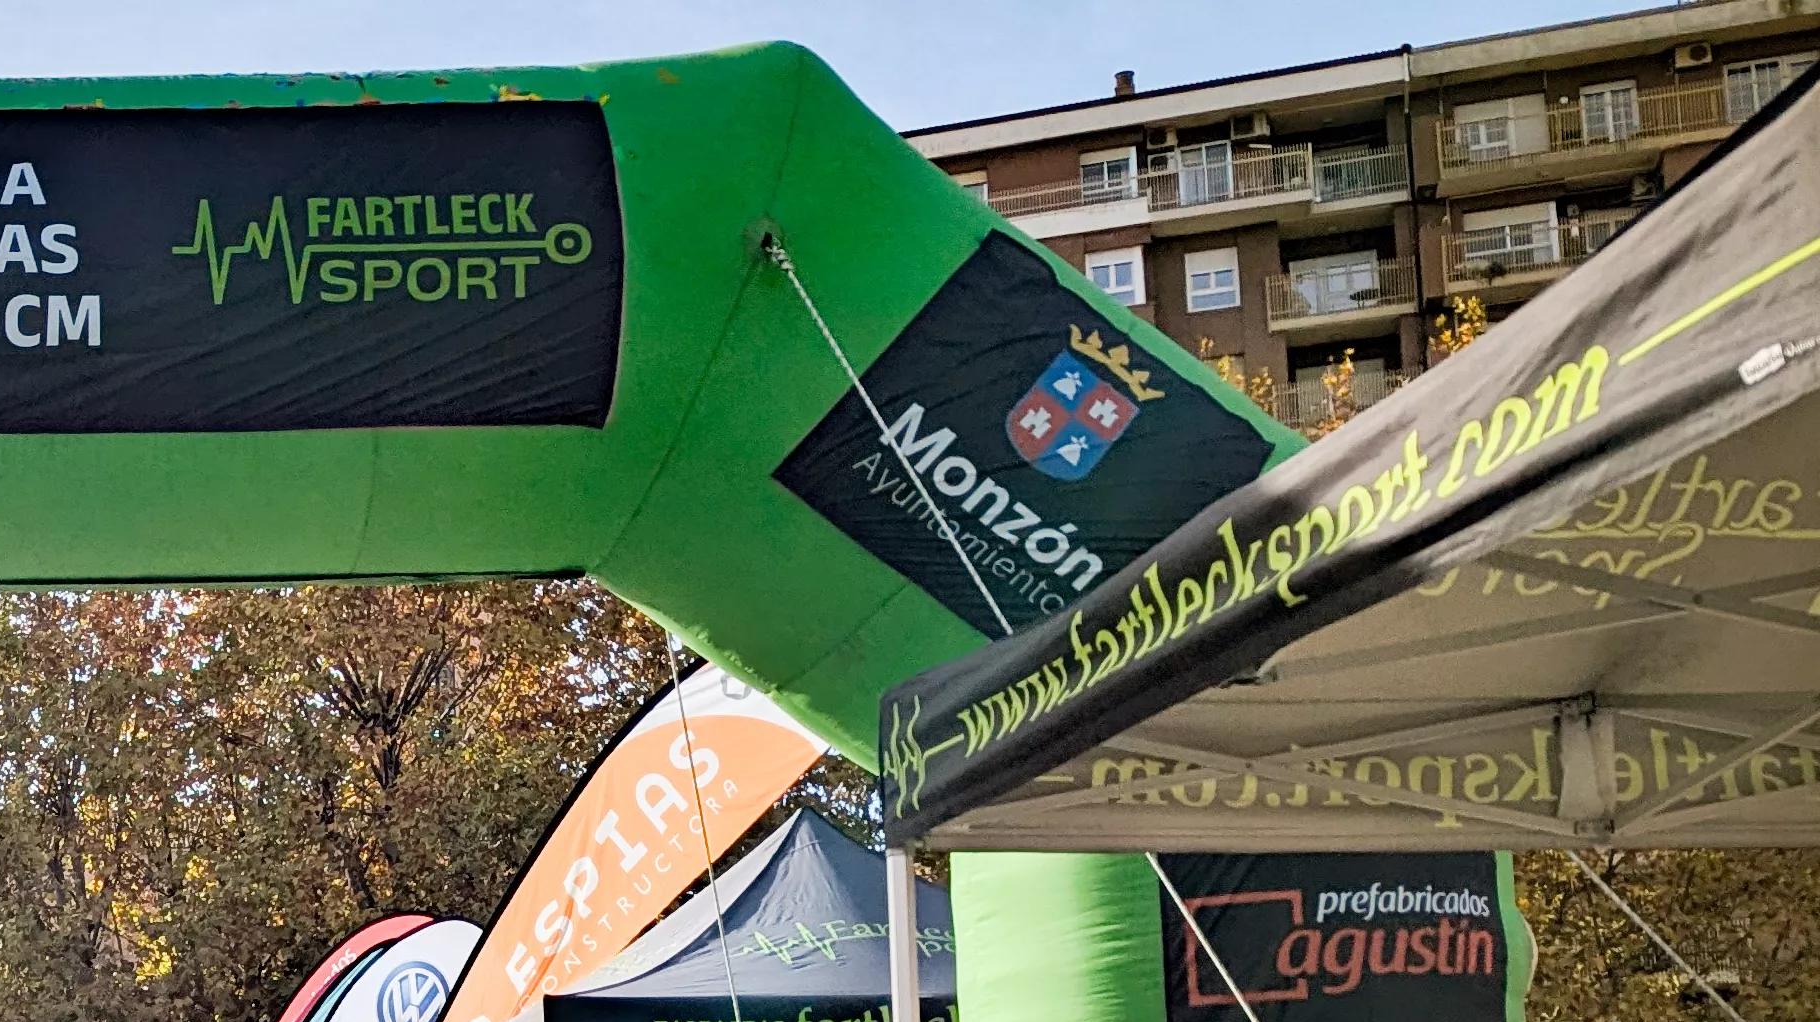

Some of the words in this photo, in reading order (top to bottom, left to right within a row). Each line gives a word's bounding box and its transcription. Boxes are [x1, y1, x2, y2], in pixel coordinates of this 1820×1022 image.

[307, 194, 538, 237] FARTLECK
[5, 294, 101, 348] CM
[320, 256, 540, 302] SPORT
[853, 452, 1064, 615] Ayuntamiento
[880, 403, 1103, 591] Monzón
[957, 345, 1610, 759] www.fartlecksport.com
[505, 729, 720, 995] ESPIAS
[1316, 882, 1490, 923] prefabricados
